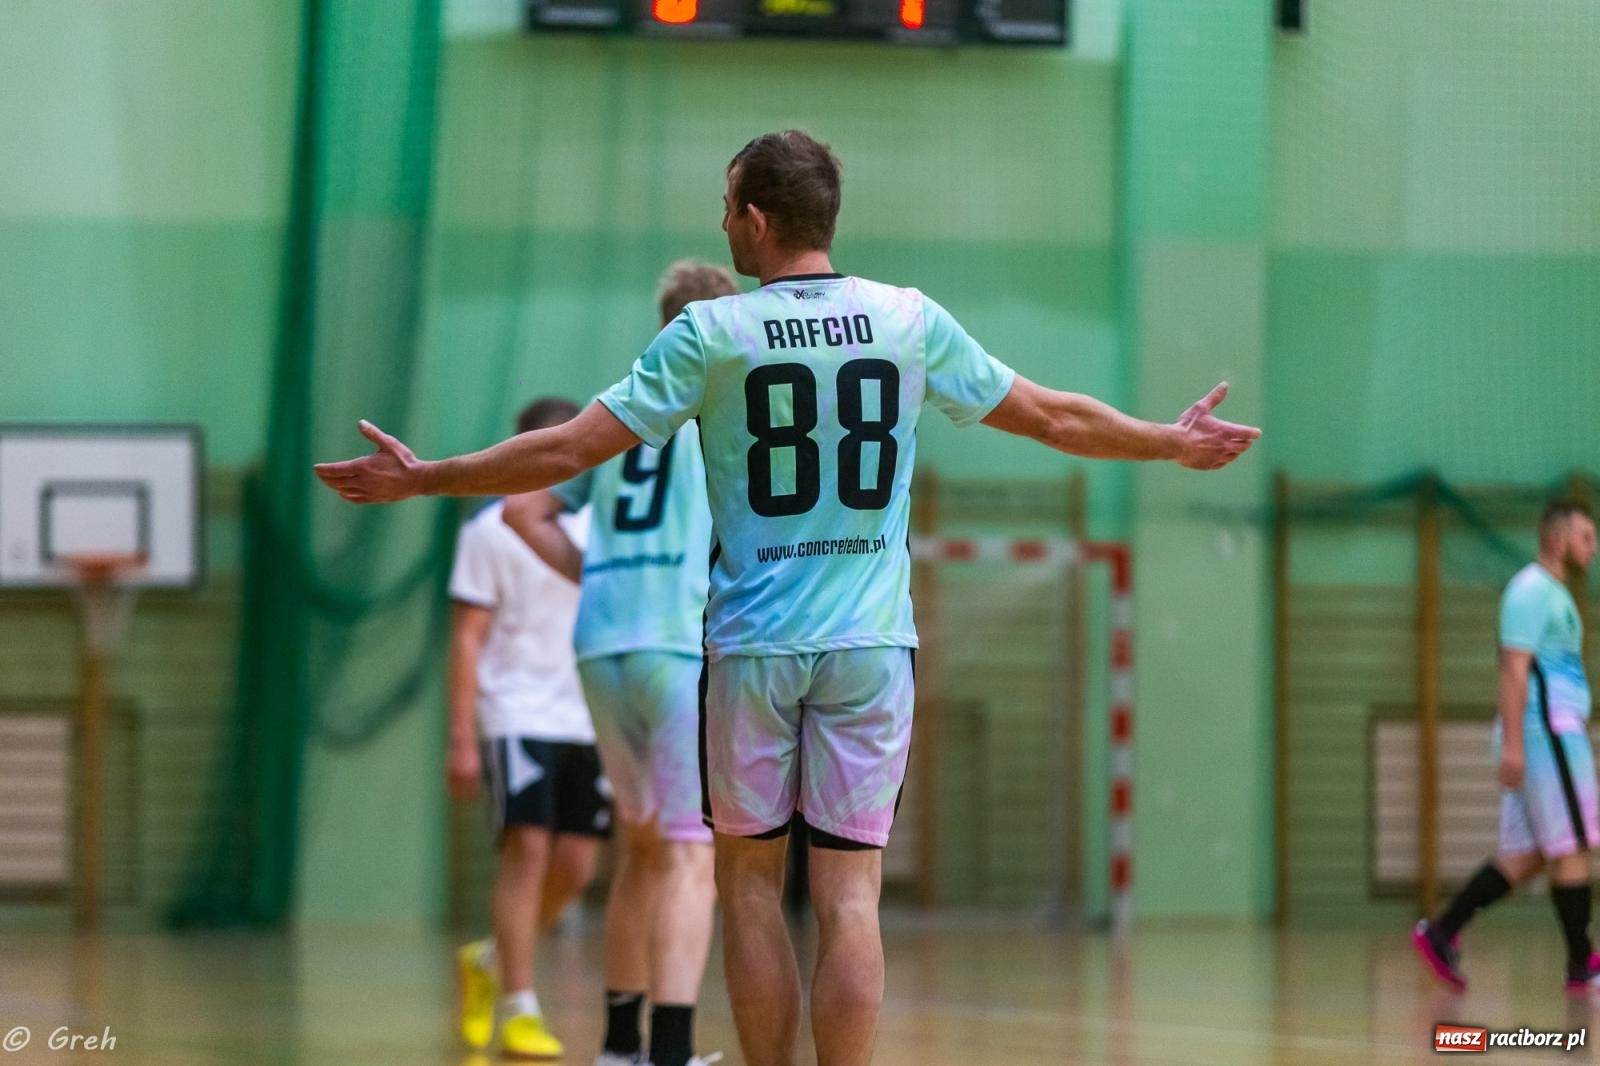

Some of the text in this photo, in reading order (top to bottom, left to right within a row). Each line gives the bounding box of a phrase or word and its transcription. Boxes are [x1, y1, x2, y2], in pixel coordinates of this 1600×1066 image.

[763, 314, 874, 349] RAFCIO
[744, 358, 900, 517] 88
[614, 434, 675, 532] 9
[757, 534, 886, 563] www.concretedm.pl
